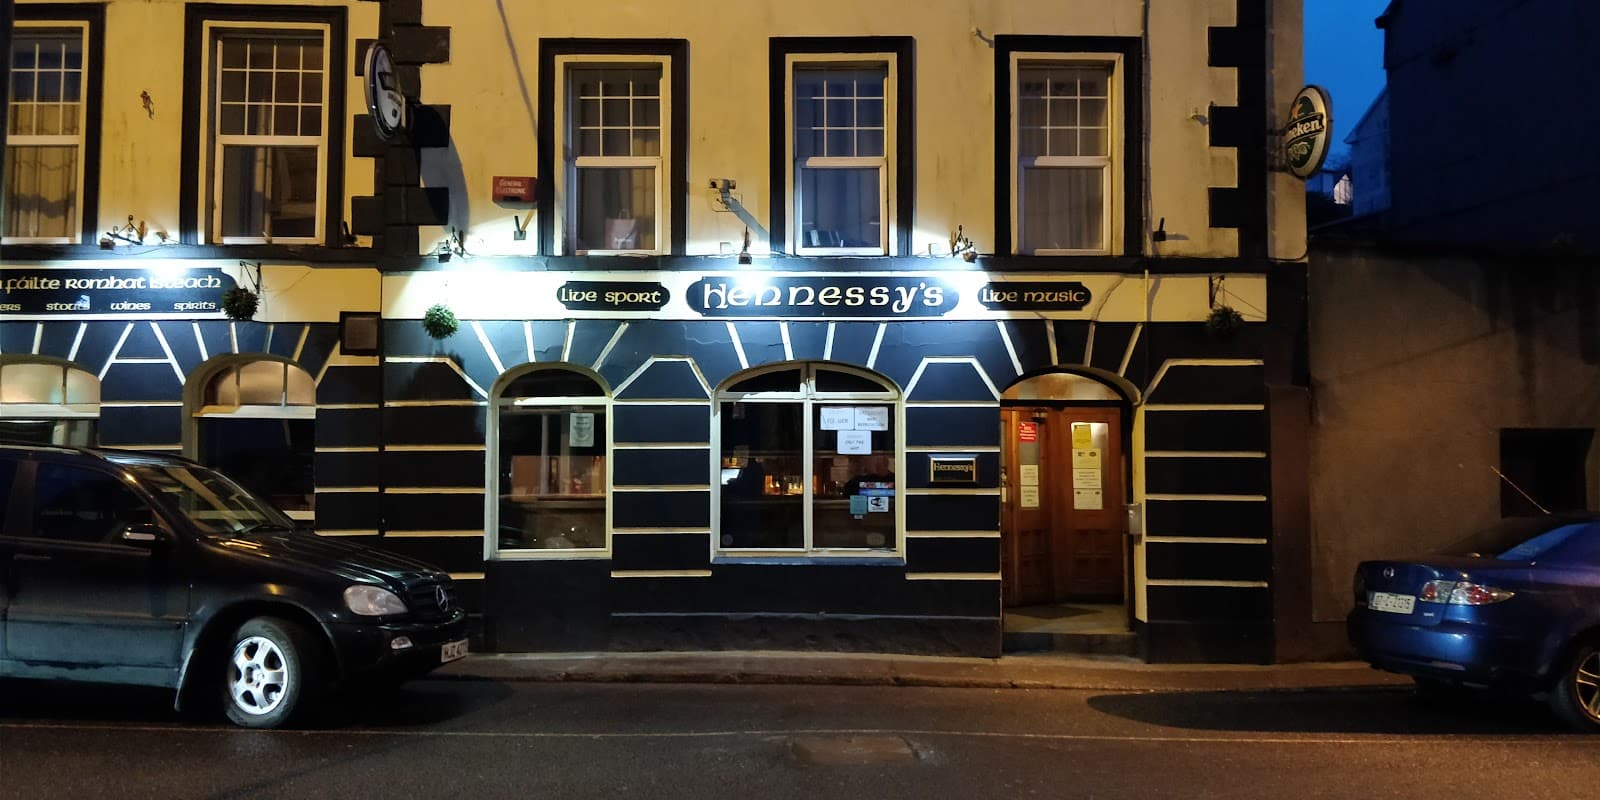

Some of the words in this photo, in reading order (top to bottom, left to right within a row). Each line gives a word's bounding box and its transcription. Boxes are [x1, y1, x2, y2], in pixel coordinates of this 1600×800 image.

[560, 287, 598, 302] Live
[604, 291, 663, 305] sport
[703, 282, 944, 314] Hennessy's
[982, 288, 1017, 303] Live
[1023, 290, 1086, 303] music
[110, 301, 151, 312] wines
[174, 301, 216, 314] spirits
